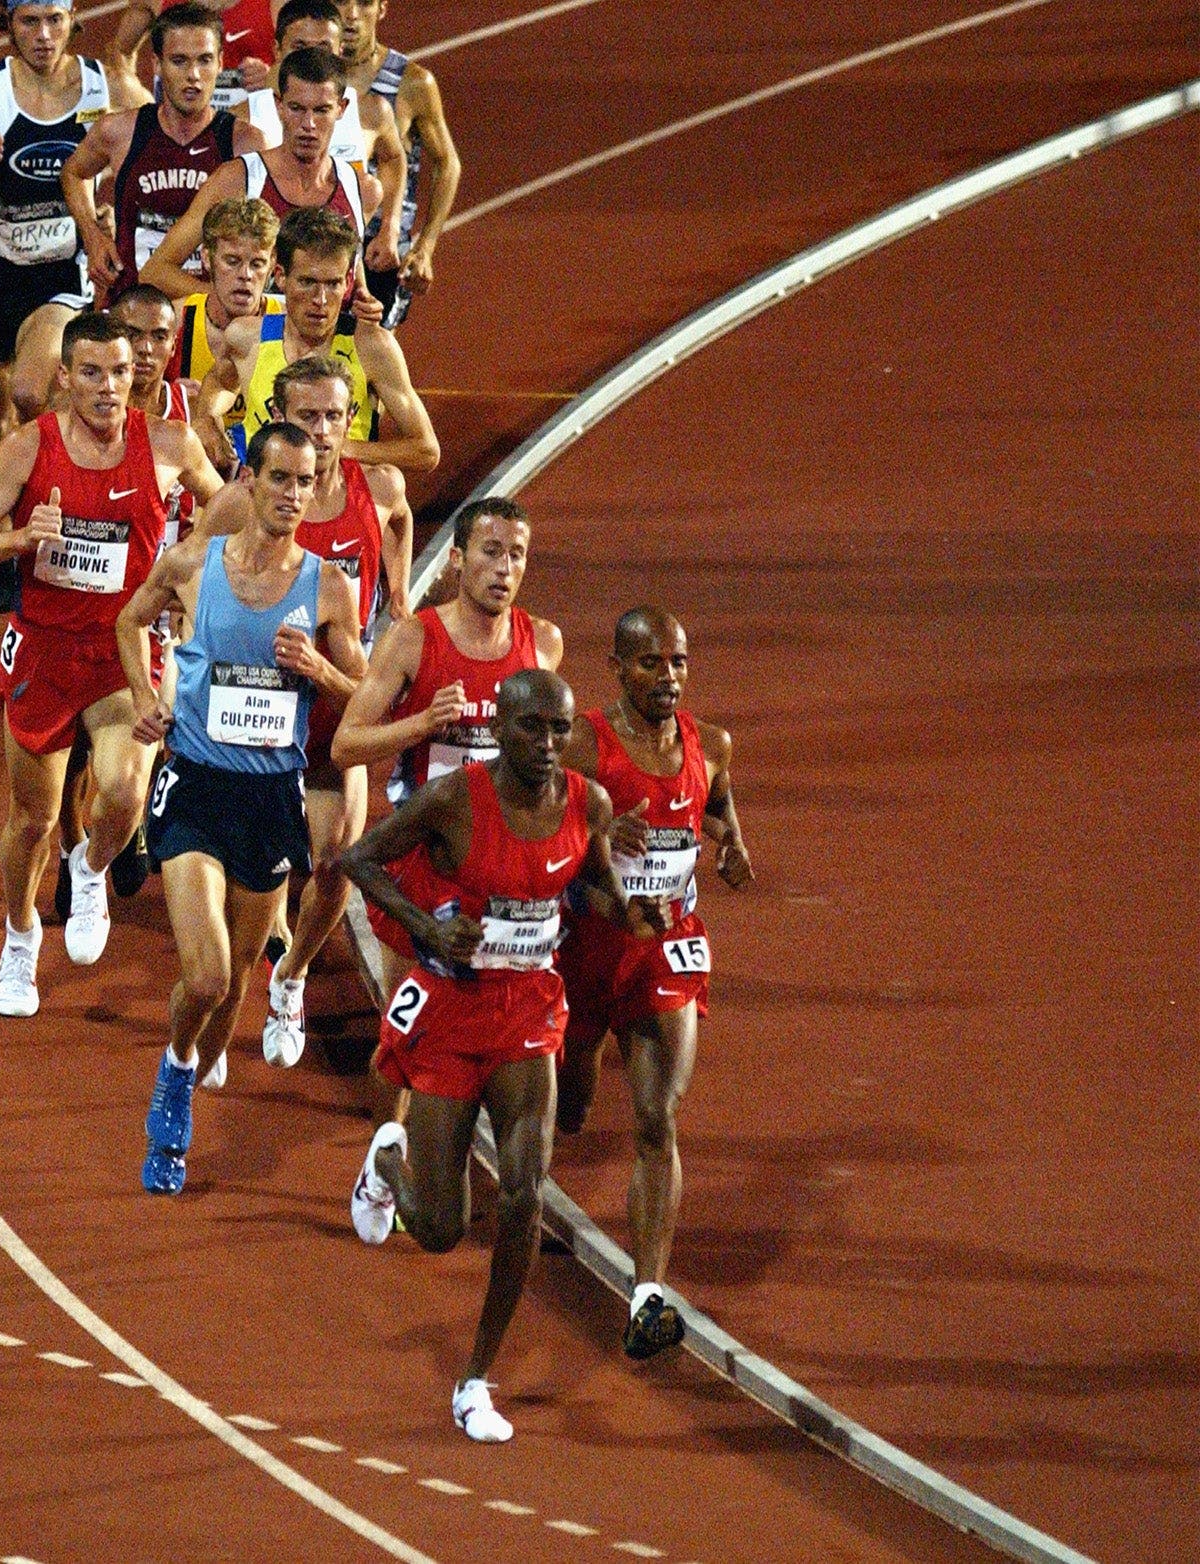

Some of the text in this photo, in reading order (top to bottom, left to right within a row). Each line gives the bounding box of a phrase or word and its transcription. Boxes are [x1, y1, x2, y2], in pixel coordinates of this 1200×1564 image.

[20, 158, 62, 168] NITTA
[138, 168, 209, 194] STANFOR
[64, 539, 101, 554] Daniel
[50, 551, 110, 574] BROWNE
[244, 695, 271, 709] Alan
[220, 711, 286, 731] CULPEPPER
[643, 858, 668, 871] Meb
[669, 939, 706, 969] 15
[390, 985, 421, 1029] 2
